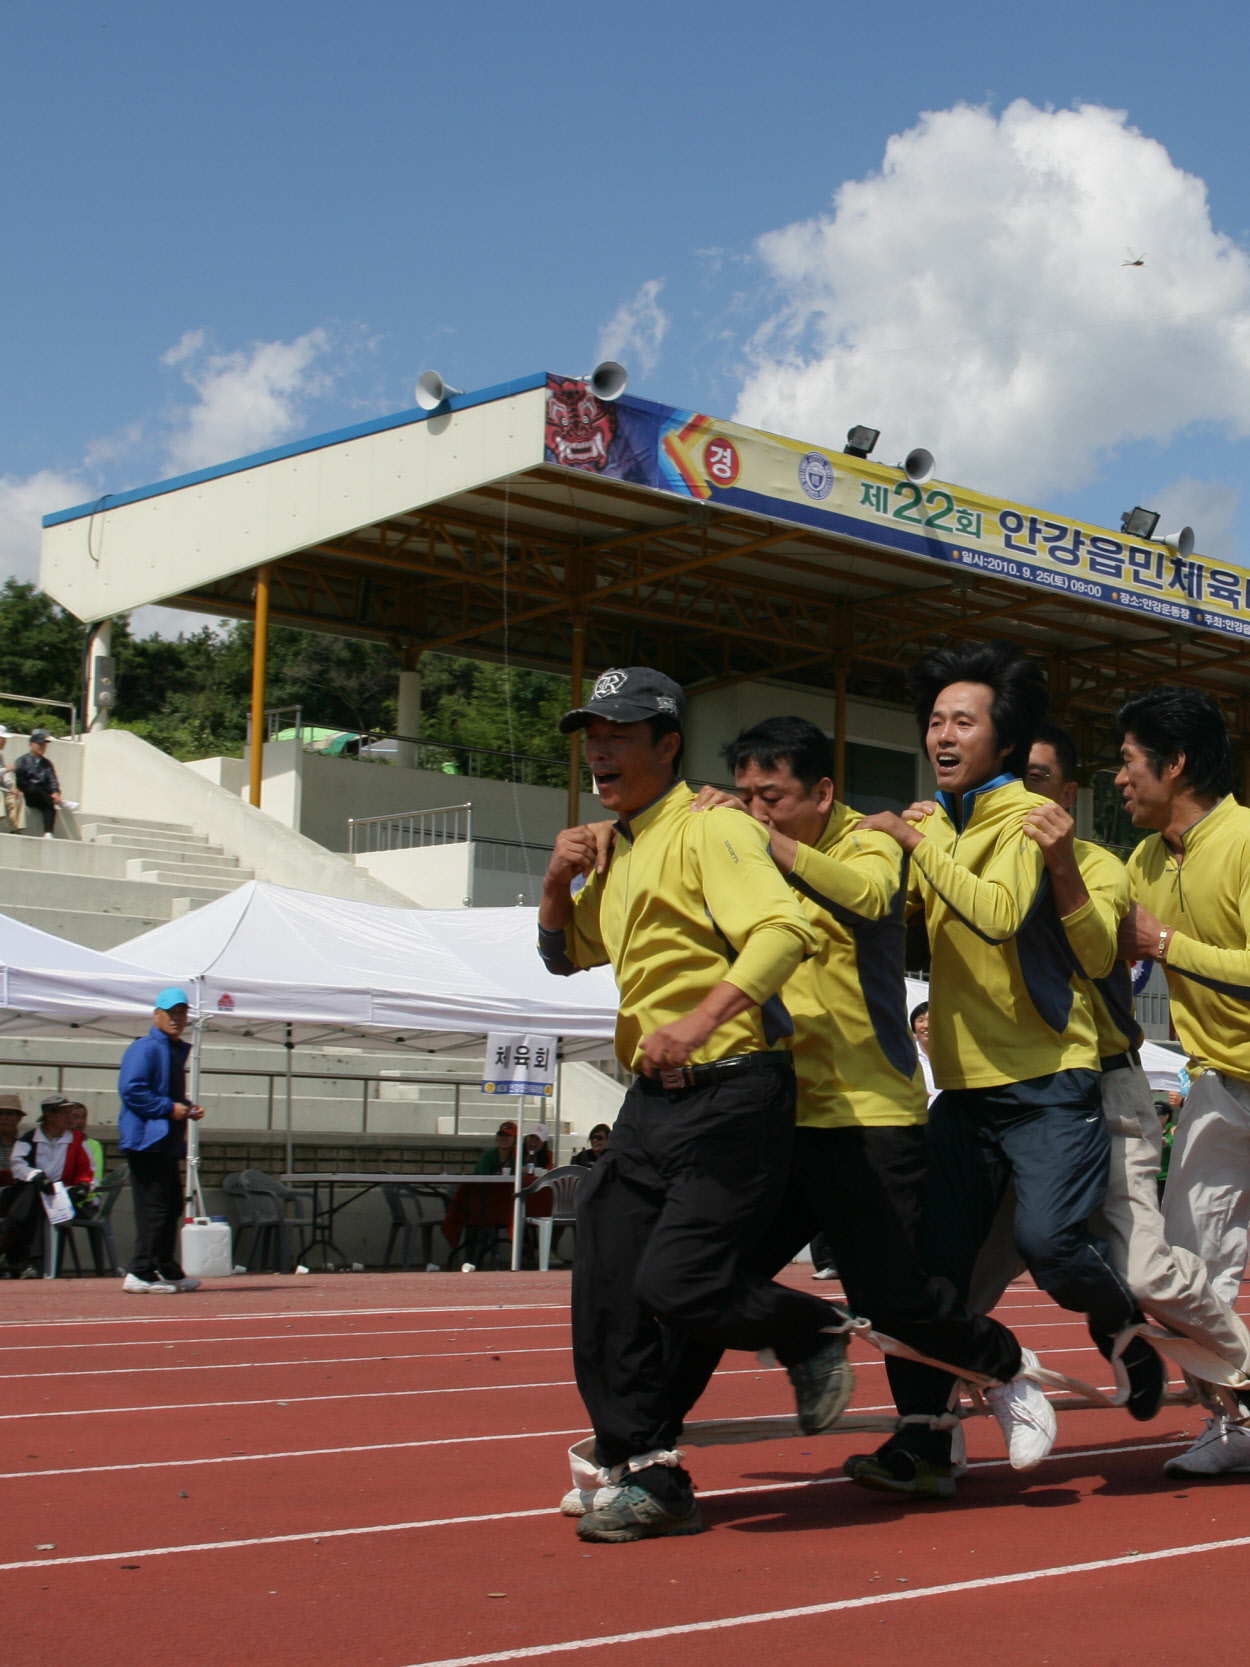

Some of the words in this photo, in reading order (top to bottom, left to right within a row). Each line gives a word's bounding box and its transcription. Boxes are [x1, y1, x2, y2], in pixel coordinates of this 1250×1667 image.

[709, 445, 732, 479] 경
[859, 482, 982, 539] 제22회
[961, 550, 1020, 576] 일시:2010.
[1022, 566, 1033, 580] 9.
[1036, 570, 1068, 589] 25(토)
[1070, 579, 1102, 597] 09:00
[1119, 591, 1191, 620] 장소:안강운동장
[494, 1045, 550, 1071] 체육회
